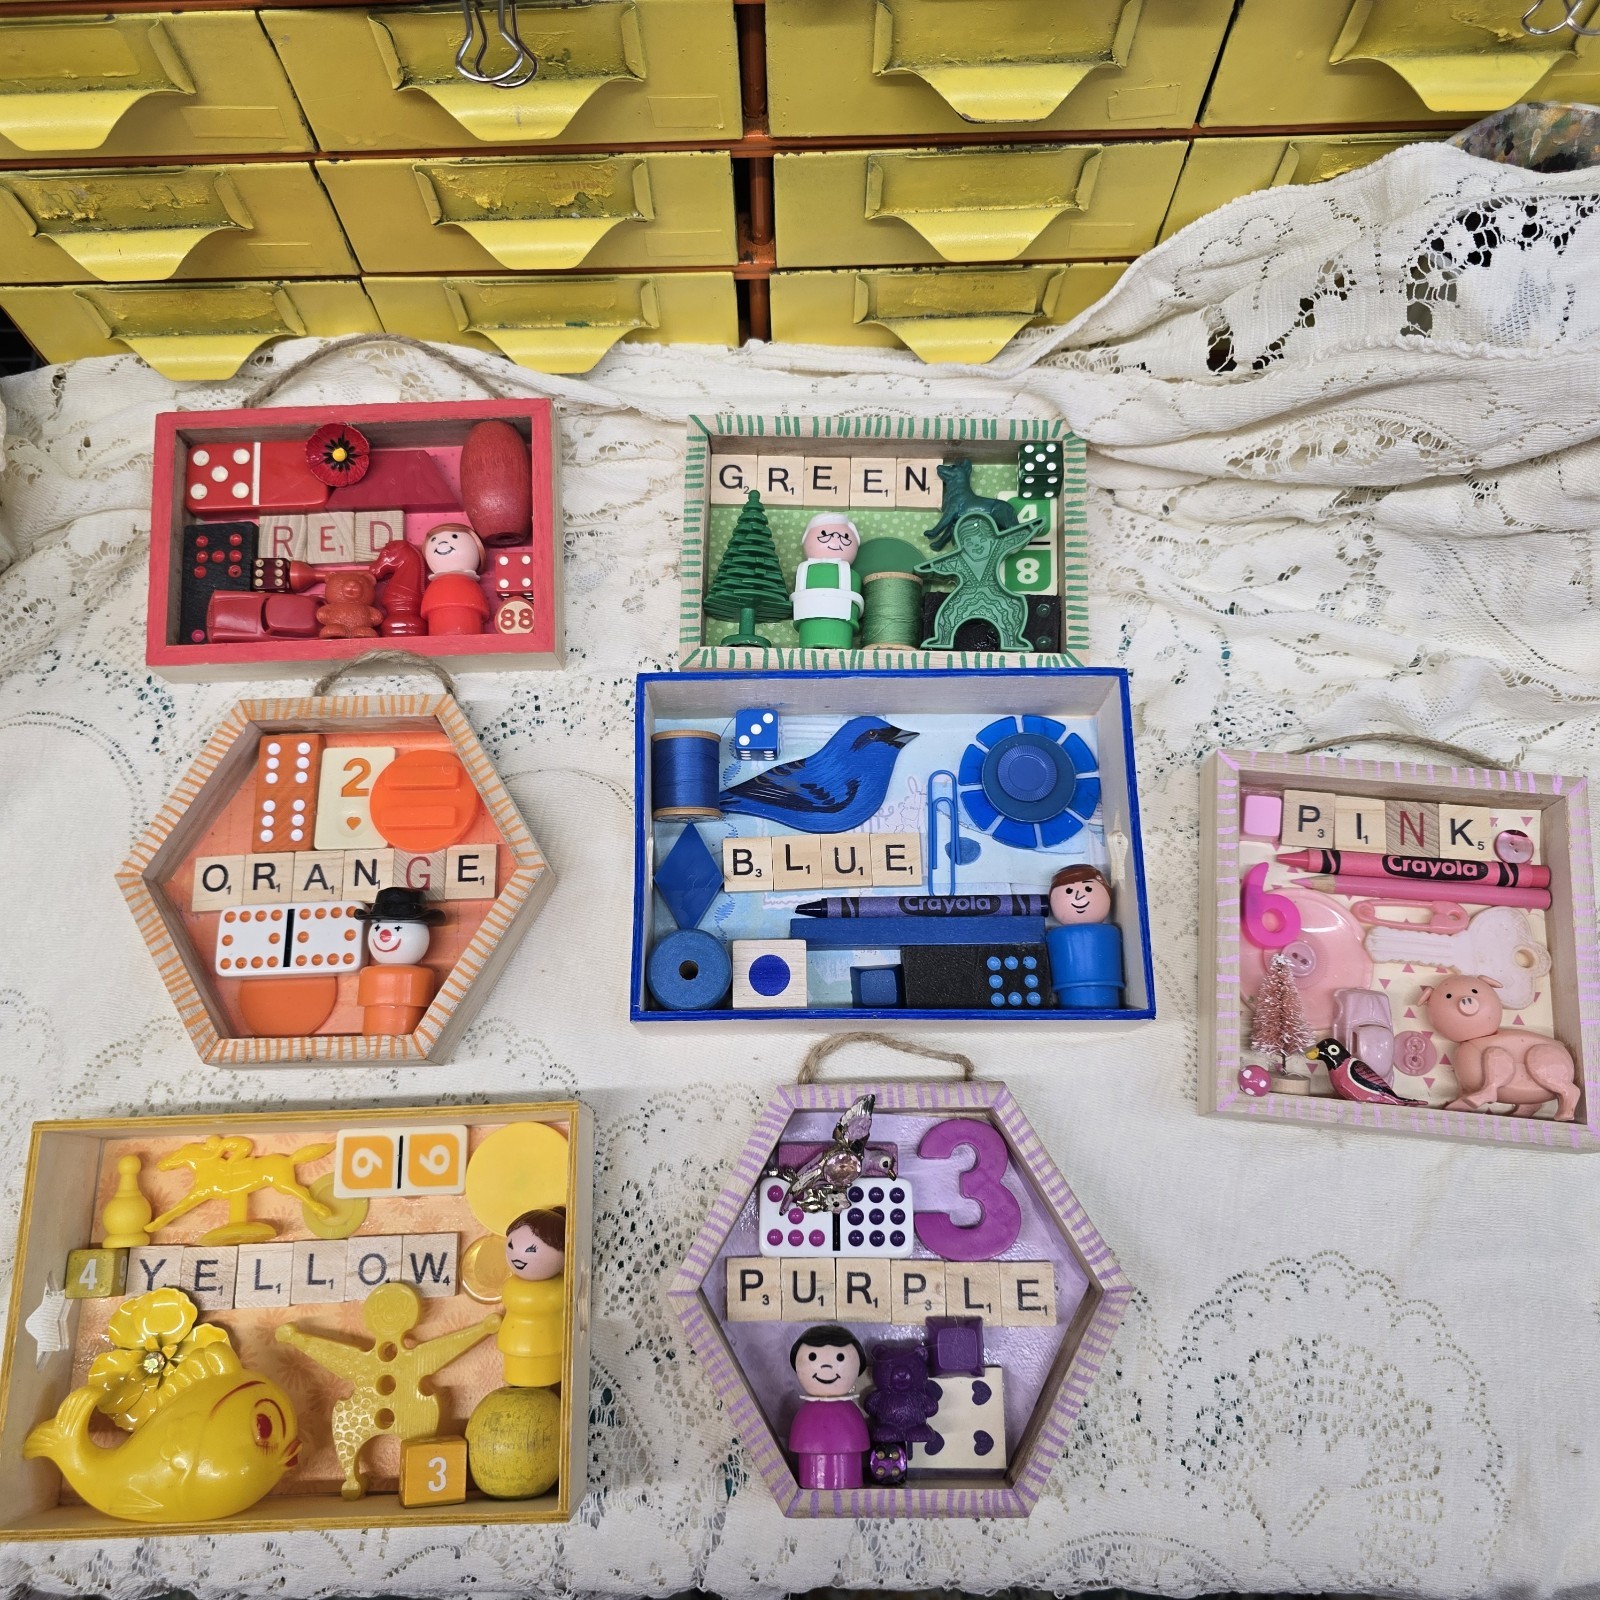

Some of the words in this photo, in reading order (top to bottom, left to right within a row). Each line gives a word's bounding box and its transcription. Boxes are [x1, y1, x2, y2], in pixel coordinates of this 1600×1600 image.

[719, 464, 927, 494] GREEN
[273, 520, 393, 557] RED
[1016, 557, 1040, 585] 8
[501, 609, 534, 630] 88
[341, 757, 372, 797] 2
[1298, 804, 1474, 848] PINK
[202, 854, 480, 892] ORANGE
[732, 844, 907, 876] BLUE
[1387, 856, 1478, 877] Crayola
[904, 896, 991, 914] Crayola
[1241, 861, 1300, 949] 6
[914, 1118, 1022, 1262] 3
[79, 1258, 97, 1290] 4
[139, 1252, 448, 1291] YELLOW
[740, 1269, 1041, 1311] PURPLE
[427, 1456, 448, 1493] 3
